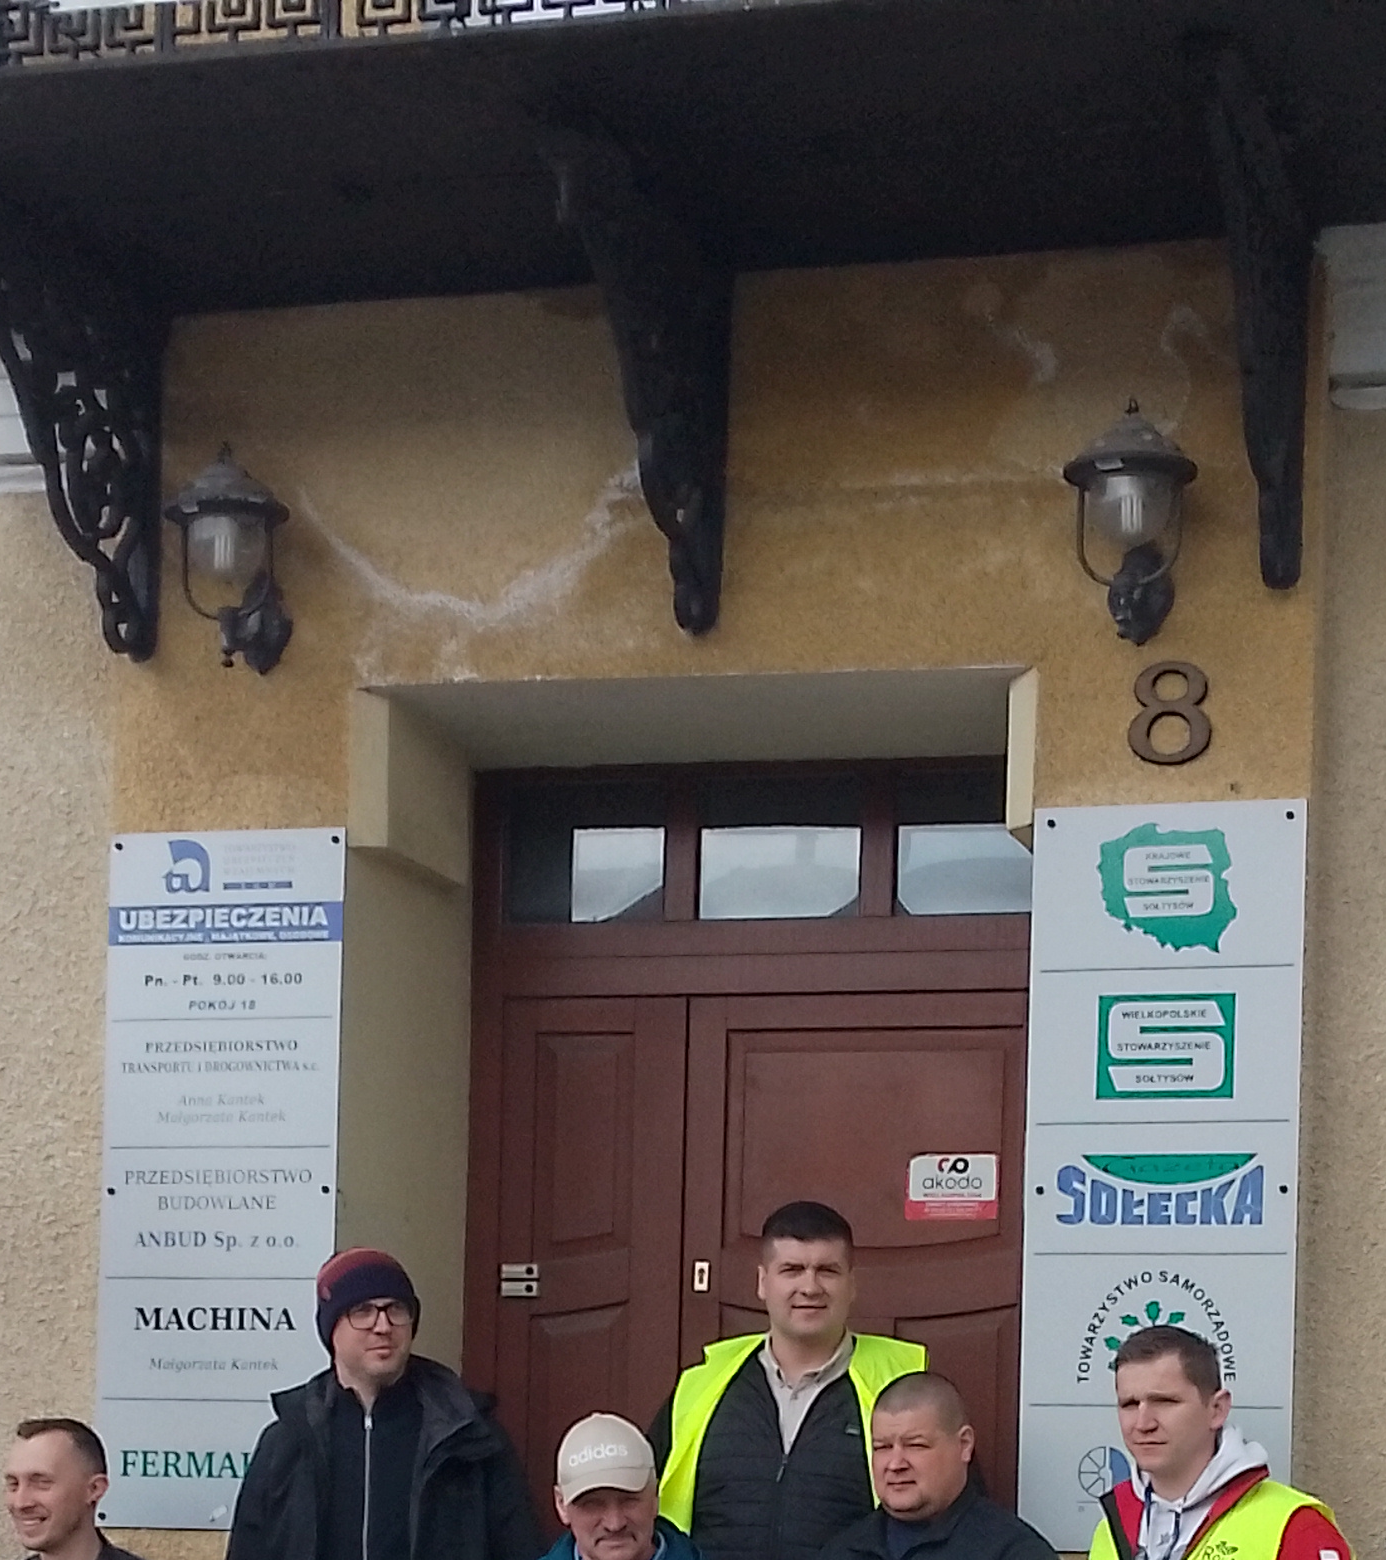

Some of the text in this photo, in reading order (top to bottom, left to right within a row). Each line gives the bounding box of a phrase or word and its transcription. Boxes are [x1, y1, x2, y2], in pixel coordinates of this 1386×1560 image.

[1127, 660, 1212, 766] 8
[119, 905, 328, 930] UBEZPIECZENIA
[213, 973, 246, 986] 9.00
[261, 972, 304, 985] 16.00
[241, 999, 257, 1010] 18
[1121, 1008, 1208, 1020] WIELKOPOLSKIE
[1117, 1040, 1212, 1052] STOWARZYSZENIE
[158, 1195, 277, 1211] BUDOWLANE
[135, 1231, 207, 1248] ANBUD
[134, 1306, 297, 1331] MACHINA
[1077, 1271, 1153, 1384] TOWARZYSTWO
[569, 1443, 629, 1467] adidas
